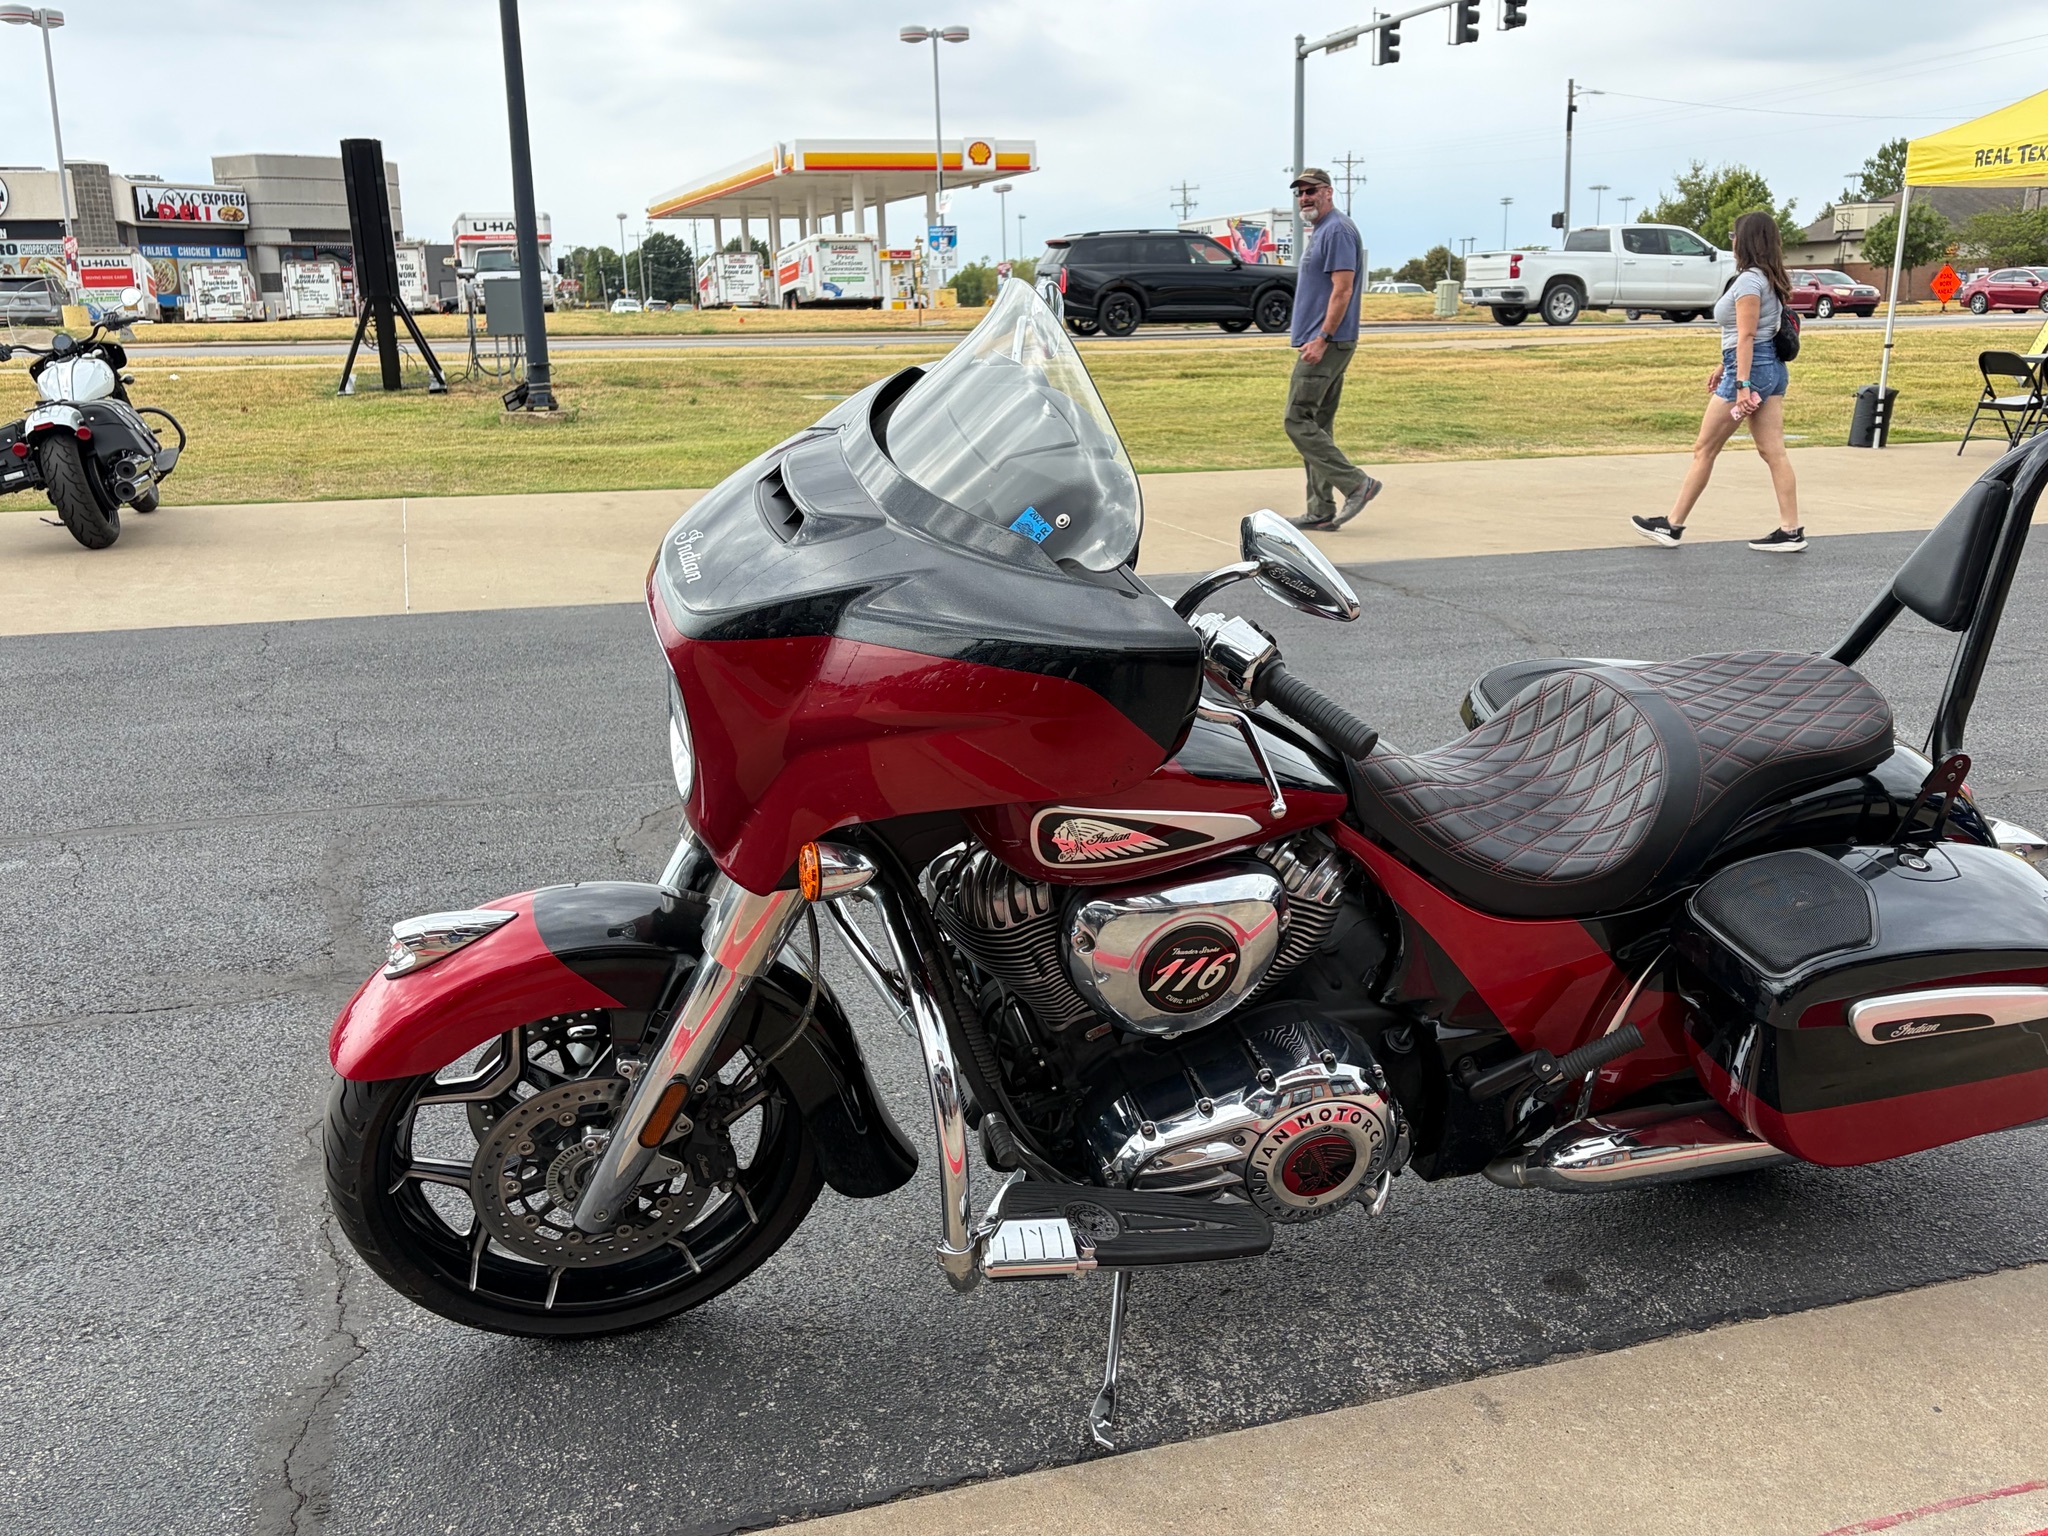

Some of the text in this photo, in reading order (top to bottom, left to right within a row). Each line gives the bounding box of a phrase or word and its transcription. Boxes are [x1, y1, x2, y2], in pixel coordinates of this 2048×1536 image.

[1974, 143, 2048, 168] REAL TEX
[201, 193, 245, 207] EXPRESS
[157, 203, 212, 221] DELI
[473, 221, 516, 232] U-HA
[20, 244, 48, 256] CHOPPED
[48, 244, 64, 256] CHEE
[142, 246, 241, 257] FALAFEL CHICKEN LAMB
[81, 259, 128, 268] U-HAUL
[400, 263, 414, 271] YOU
[674, 529, 704, 584] Indian
[1268, 567, 1318, 598] Indian
[1086, 831, 1131, 846] Indian
[1147, 952, 1237, 992] 116
[1165, 992, 1210, 1004] CUBIC INCHES
[1890, 1021, 1941, 1038] Indian
[1253, 1128, 1291, 1204] INDIAN
